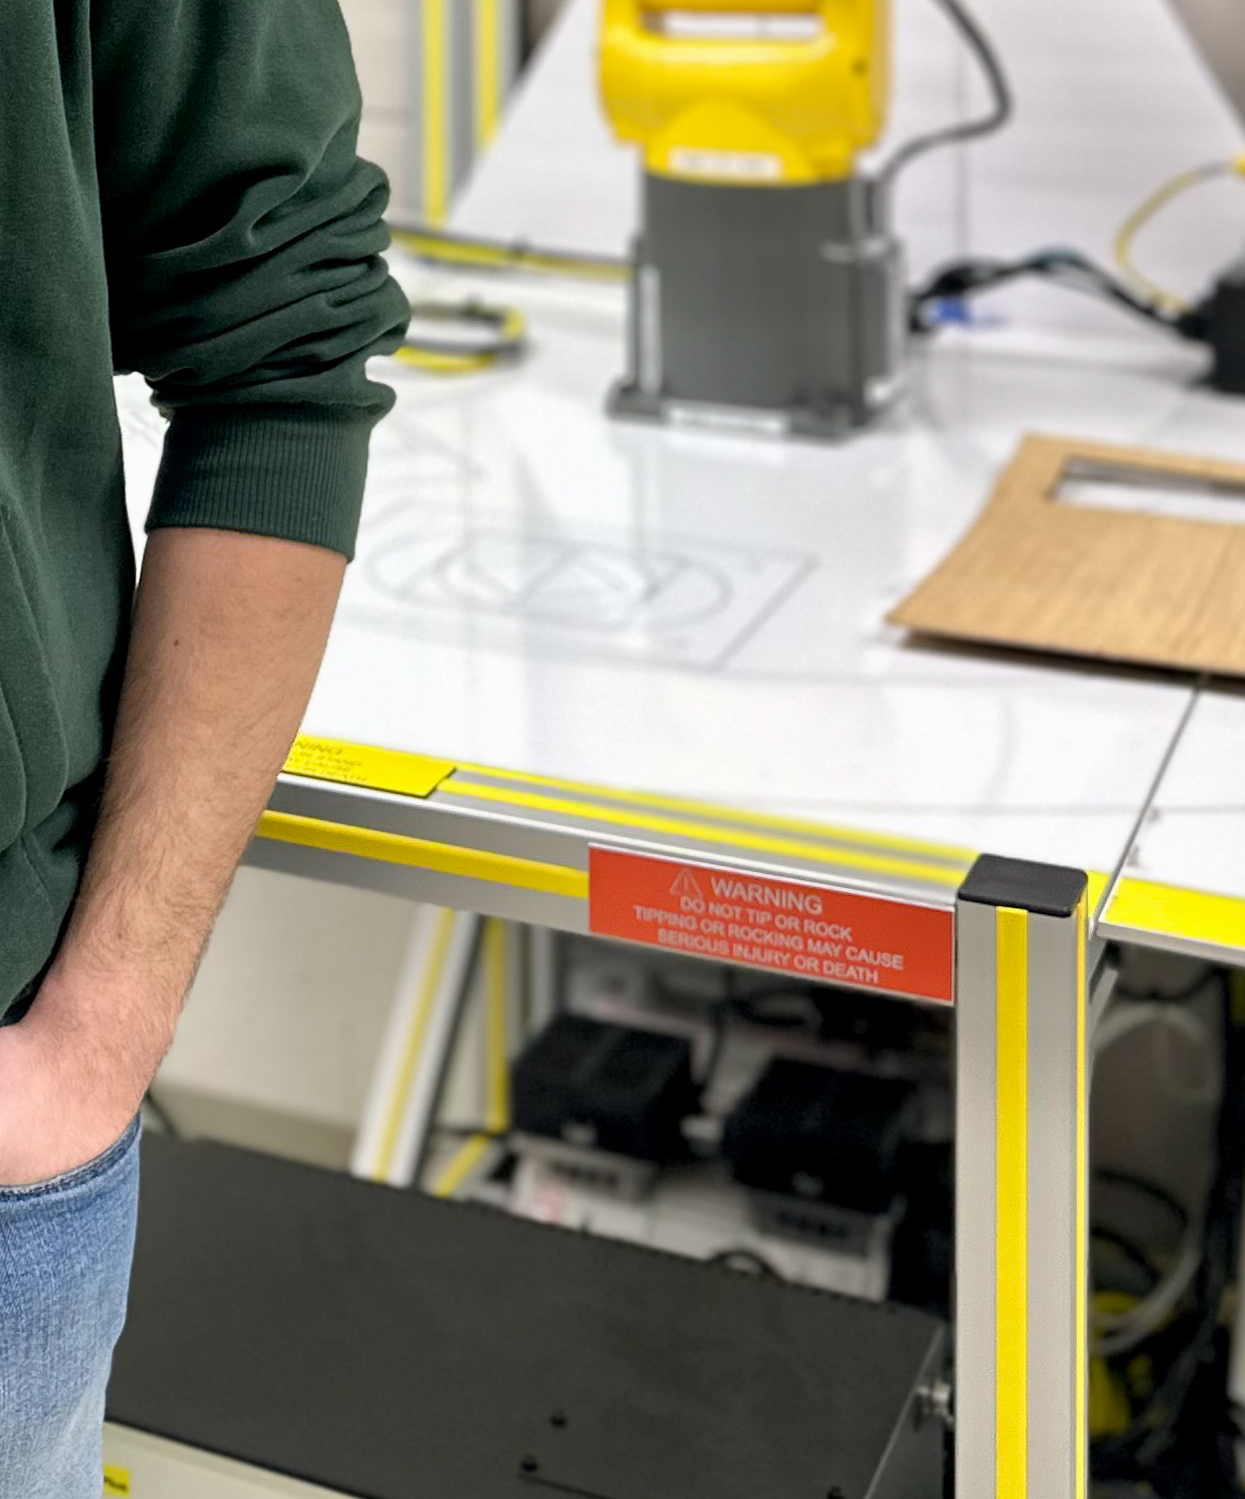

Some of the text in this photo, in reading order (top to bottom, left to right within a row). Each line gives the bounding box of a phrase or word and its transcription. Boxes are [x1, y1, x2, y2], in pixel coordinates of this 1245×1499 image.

[680, 896, 852, 942] DO NOT TIP OR ROCK
[711, 876, 823, 915] WARNING
[634, 905, 904, 971] TIPPING OR ROCKING MAY CAUSE
[657, 928, 879, 983] SERIOUS INJURY OR DEATH
